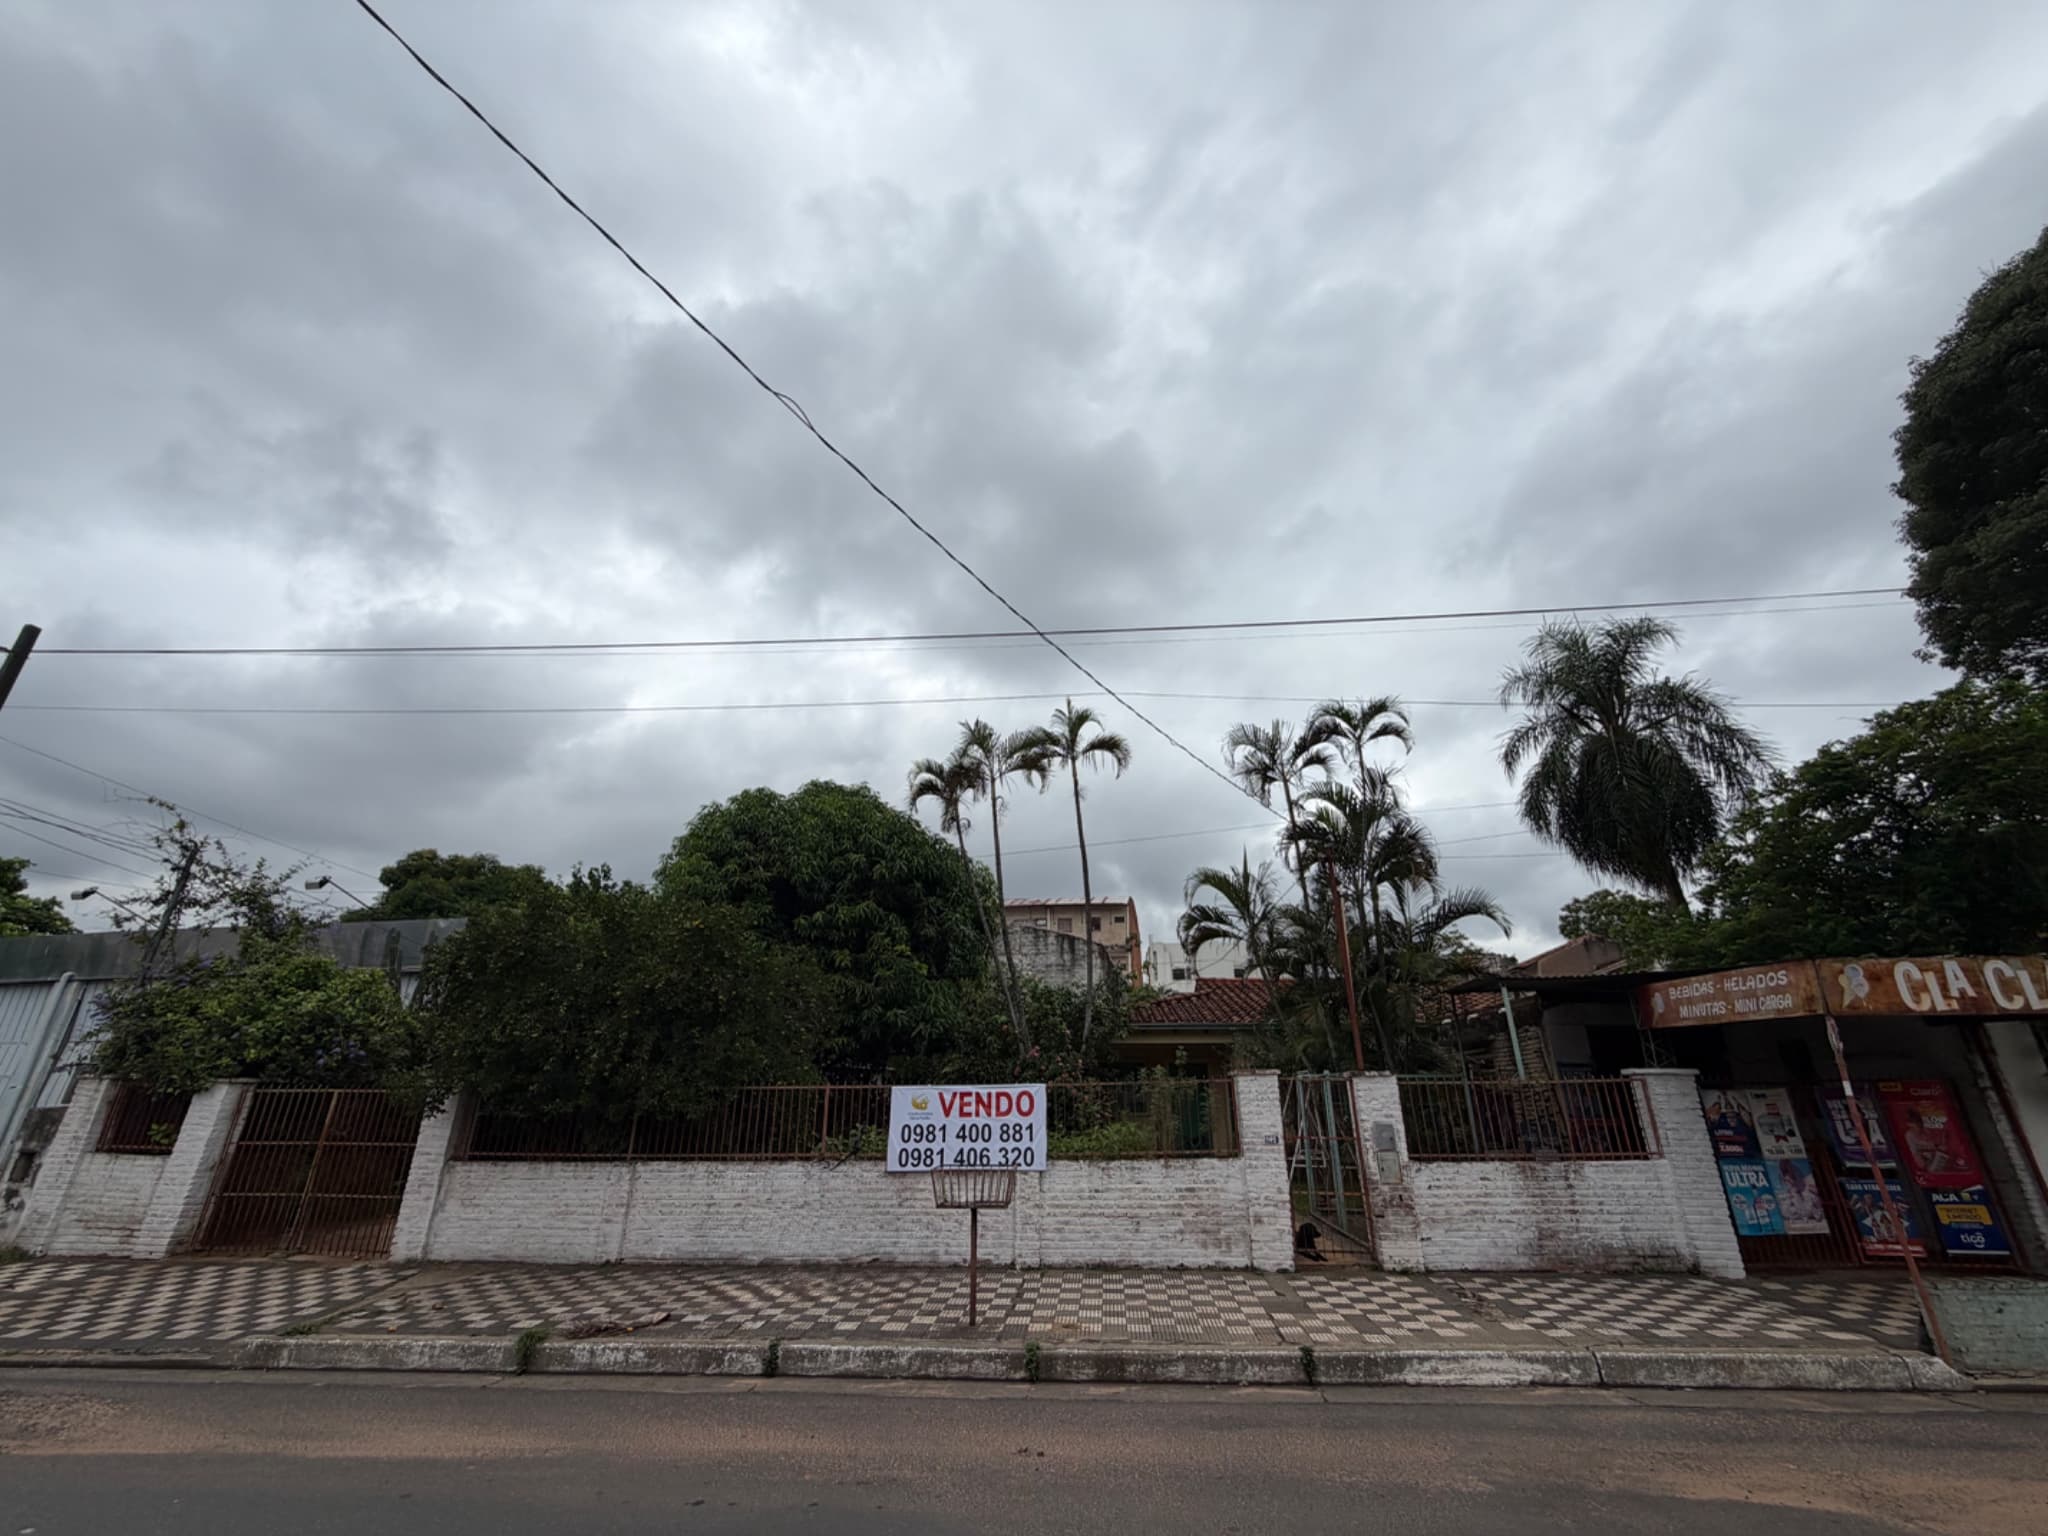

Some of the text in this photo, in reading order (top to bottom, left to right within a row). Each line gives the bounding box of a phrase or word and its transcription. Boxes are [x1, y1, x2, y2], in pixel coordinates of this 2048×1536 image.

[1668, 981, 1715, 1000] BEBIDAS
[1723, 969, 1789, 993] HELADOS
[1983, 958, 2048, 1011] CL
[1679, 1001, 1727, 1019] MINUTAS
[1734, 997, 1758, 1014] MINI
[1759, 993, 1794, 1011] CARGA
[938, 1090, 1035, 1118] VENDO
[901, 1122, 1034, 1143] 0981 400 881
[898, 1147, 1035, 1168] 0981 406 320
[1725, 1171, 1769, 1188] ULTRA
